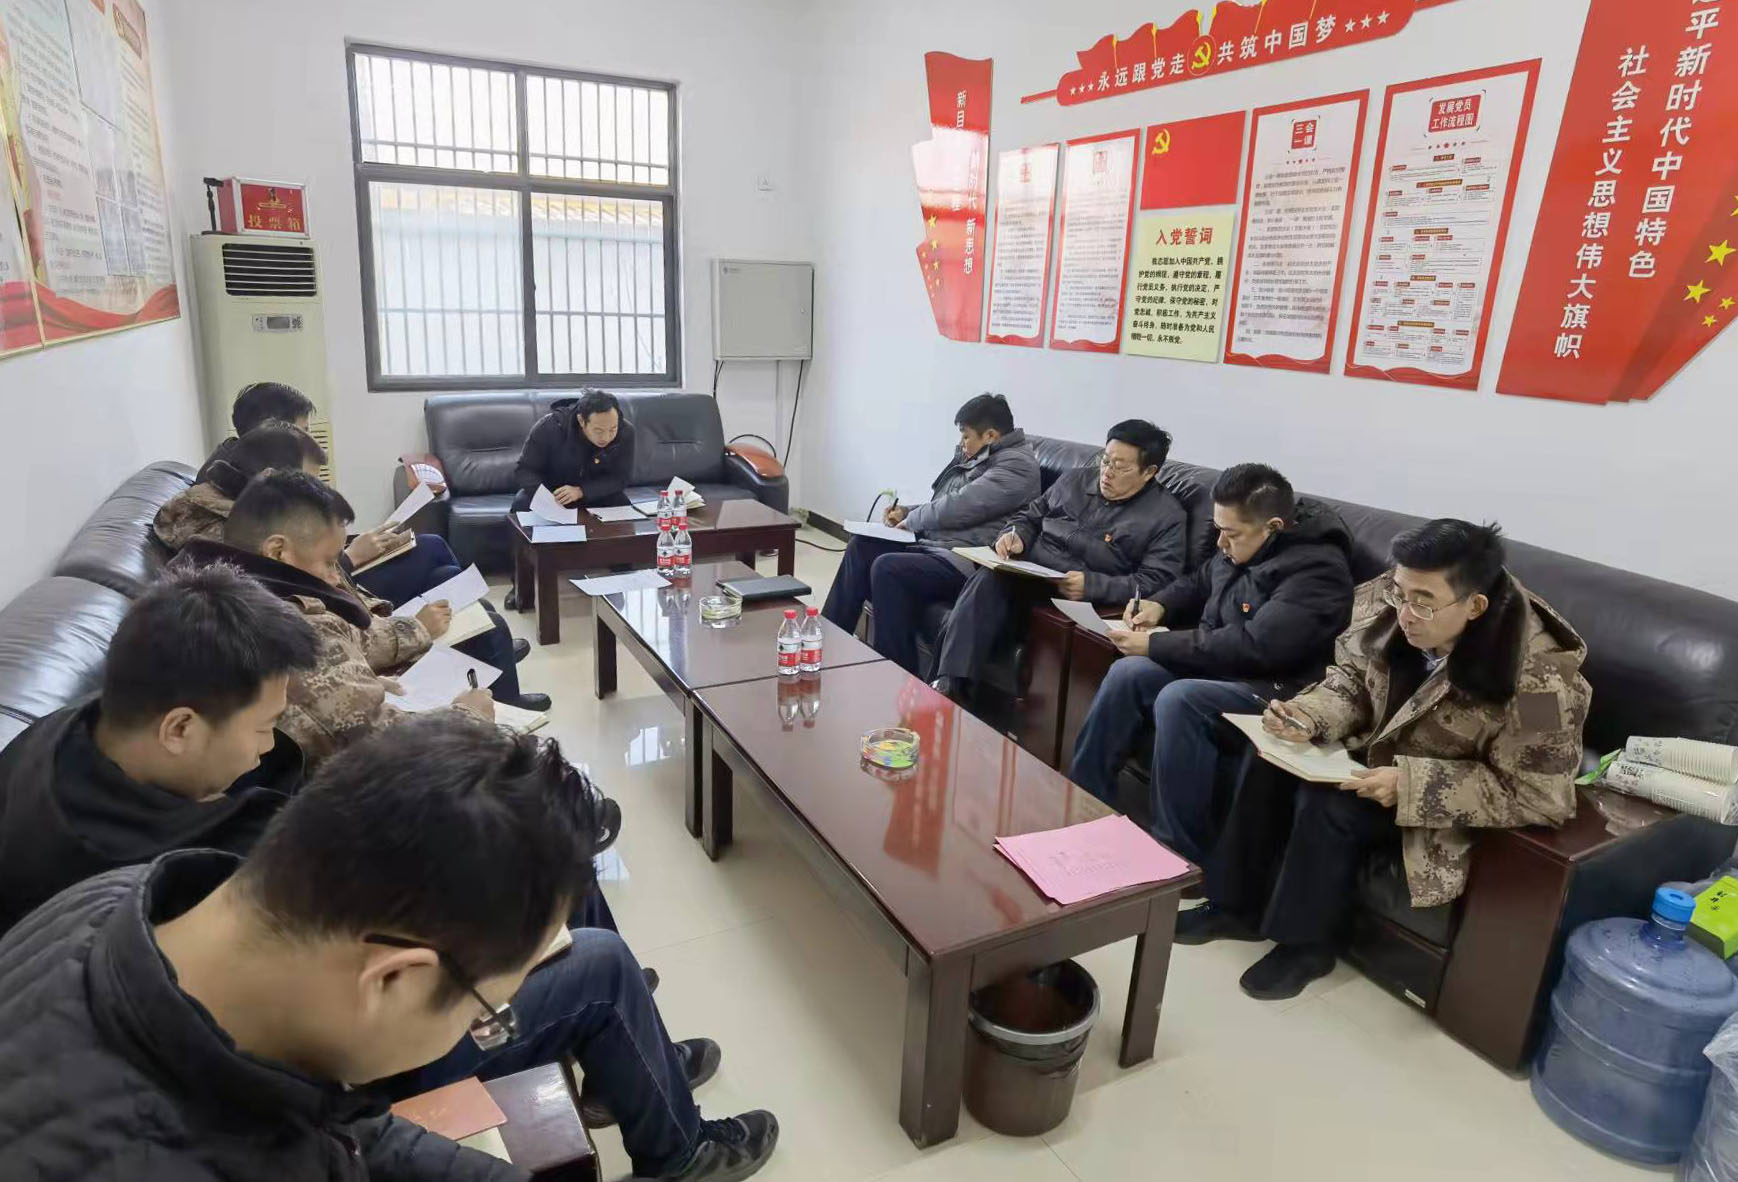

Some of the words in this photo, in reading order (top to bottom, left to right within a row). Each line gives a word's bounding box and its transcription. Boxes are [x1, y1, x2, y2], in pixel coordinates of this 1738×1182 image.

[1097, 53, 1185, 92] 永远跟党走
[1217, 13, 1336, 66] 共筑中国梦
[1438, 98, 1472, 114] 发展党员
[1294, 122, 1314, 134] 三会
[1431, 112, 1475, 129] 工作流程图
[1628, 0, 1720, 279] 平新时代中国特色
[1553, 44, 1650, 359] 社会主义思想伟大旗帜
[1155, 227, 1214, 246] 入党誓词
